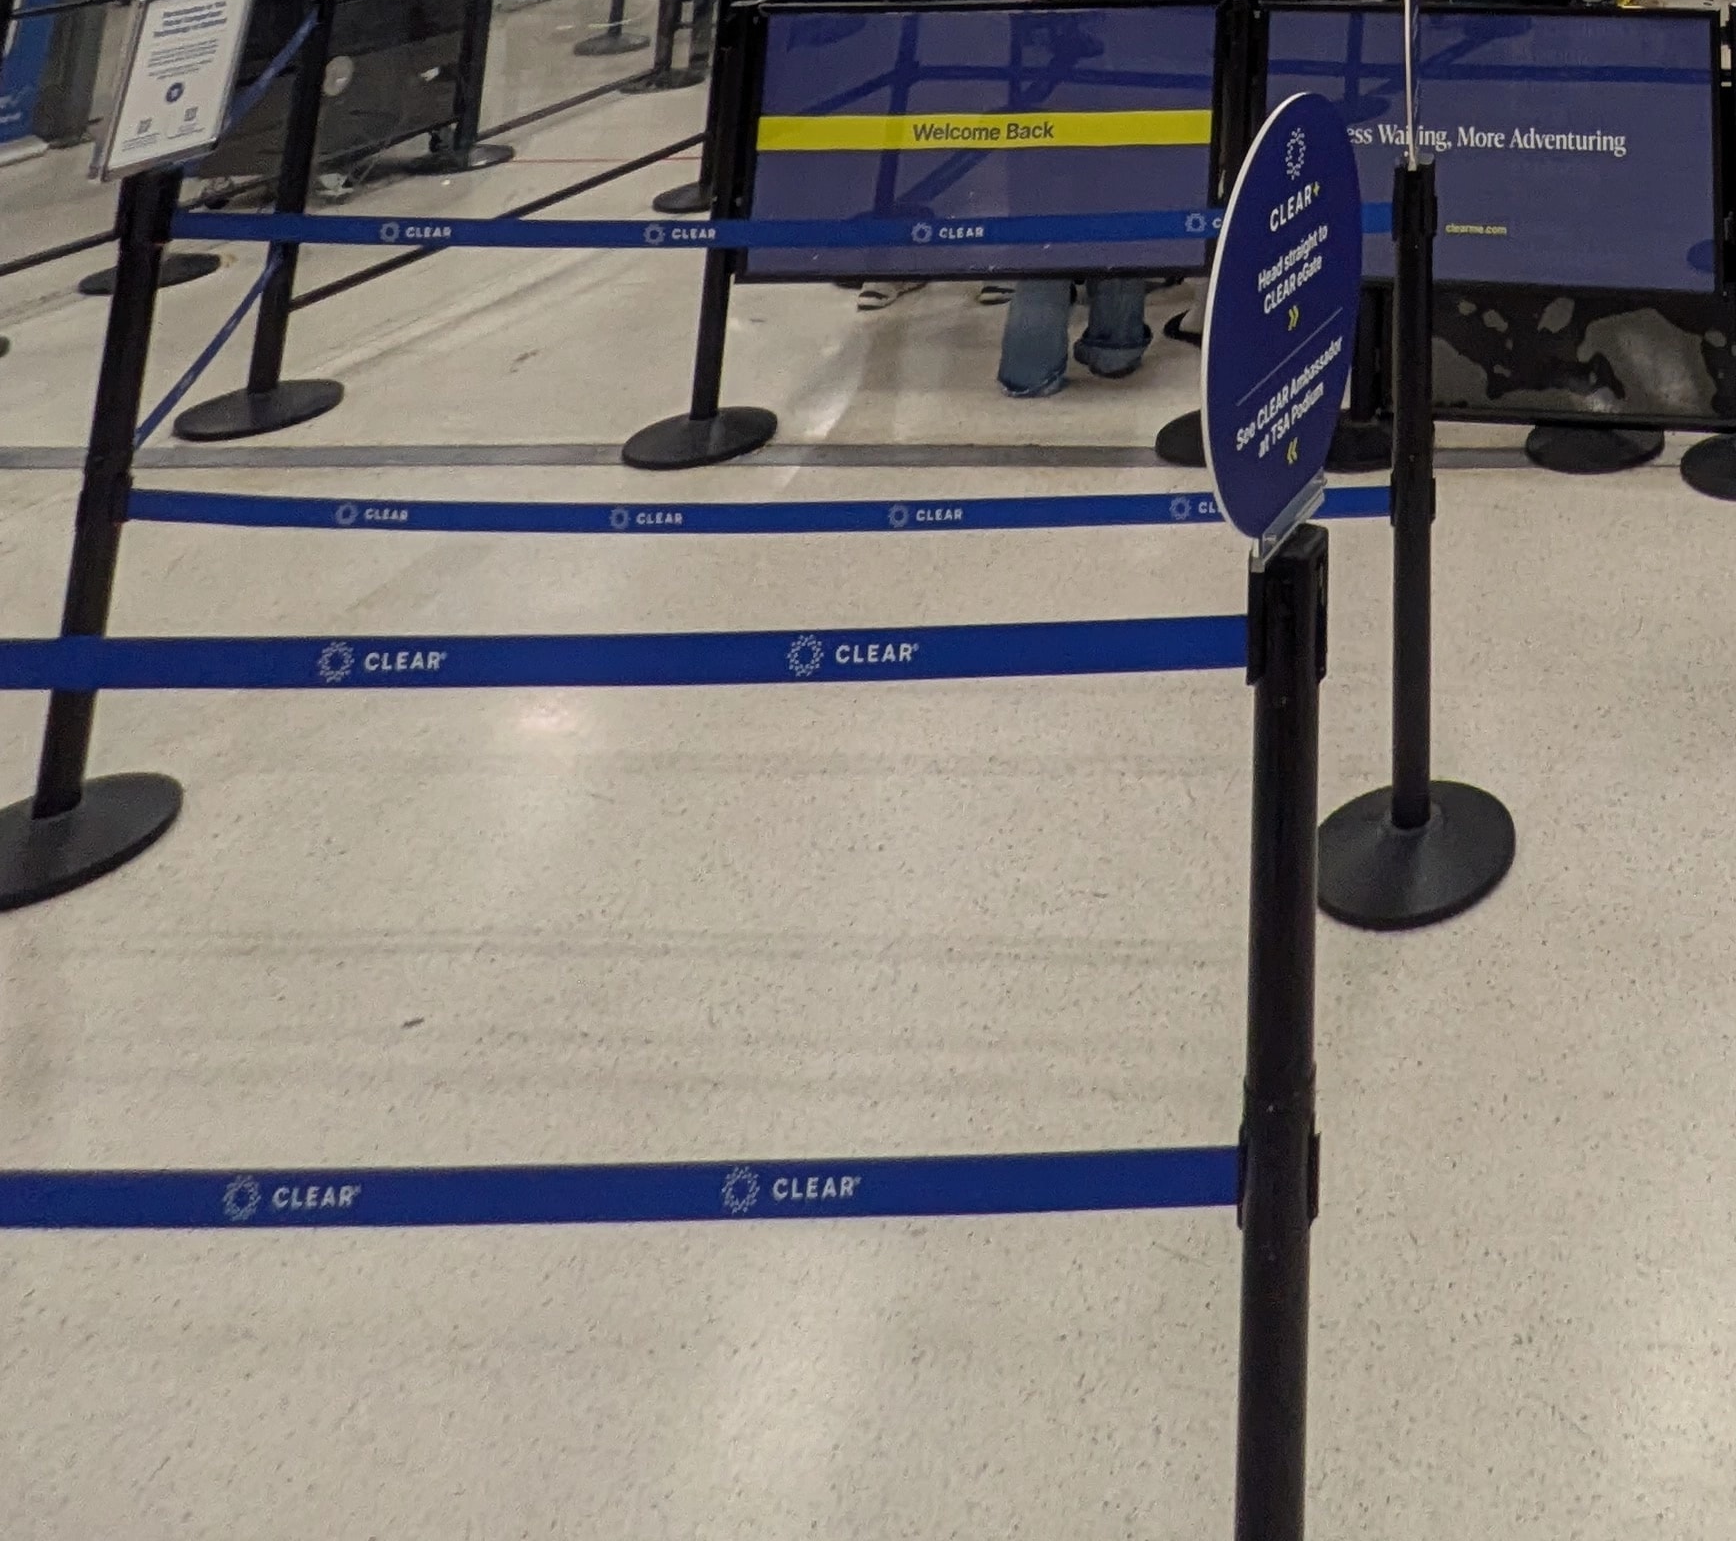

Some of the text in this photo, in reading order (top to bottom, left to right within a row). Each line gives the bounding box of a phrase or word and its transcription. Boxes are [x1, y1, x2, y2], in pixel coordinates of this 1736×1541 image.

[913, 120, 1054, 141] Welcome Back
[1347, 123, 1627, 158] ess Waiing, More Adventuring
[406, 225, 452, 239] CLEAR
[671, 227, 716, 240] CLEAR
[939, 226, 985, 239] CLEAR
[1445, 223, 1507, 235] clearme.com
[1257, 225, 1328, 293] Head straight to
[1263, 255, 1323, 315] CLEAR eGate
[1236, 335, 1343, 451] See CLEAR Ambassador
[1258, 381, 1324, 459] at TSA Podium
[365, 508, 408, 521] CLEAR
[636, 512, 683, 525] CLEAR
[915, 507, 963, 522] CLEAR
[364, 651, 441, 672] CLEAR
[835, 643, 912, 664] CLEAR
[272, 1185, 355, 1210] CLEAR
[772, 1175, 854, 1200] CLEAR
